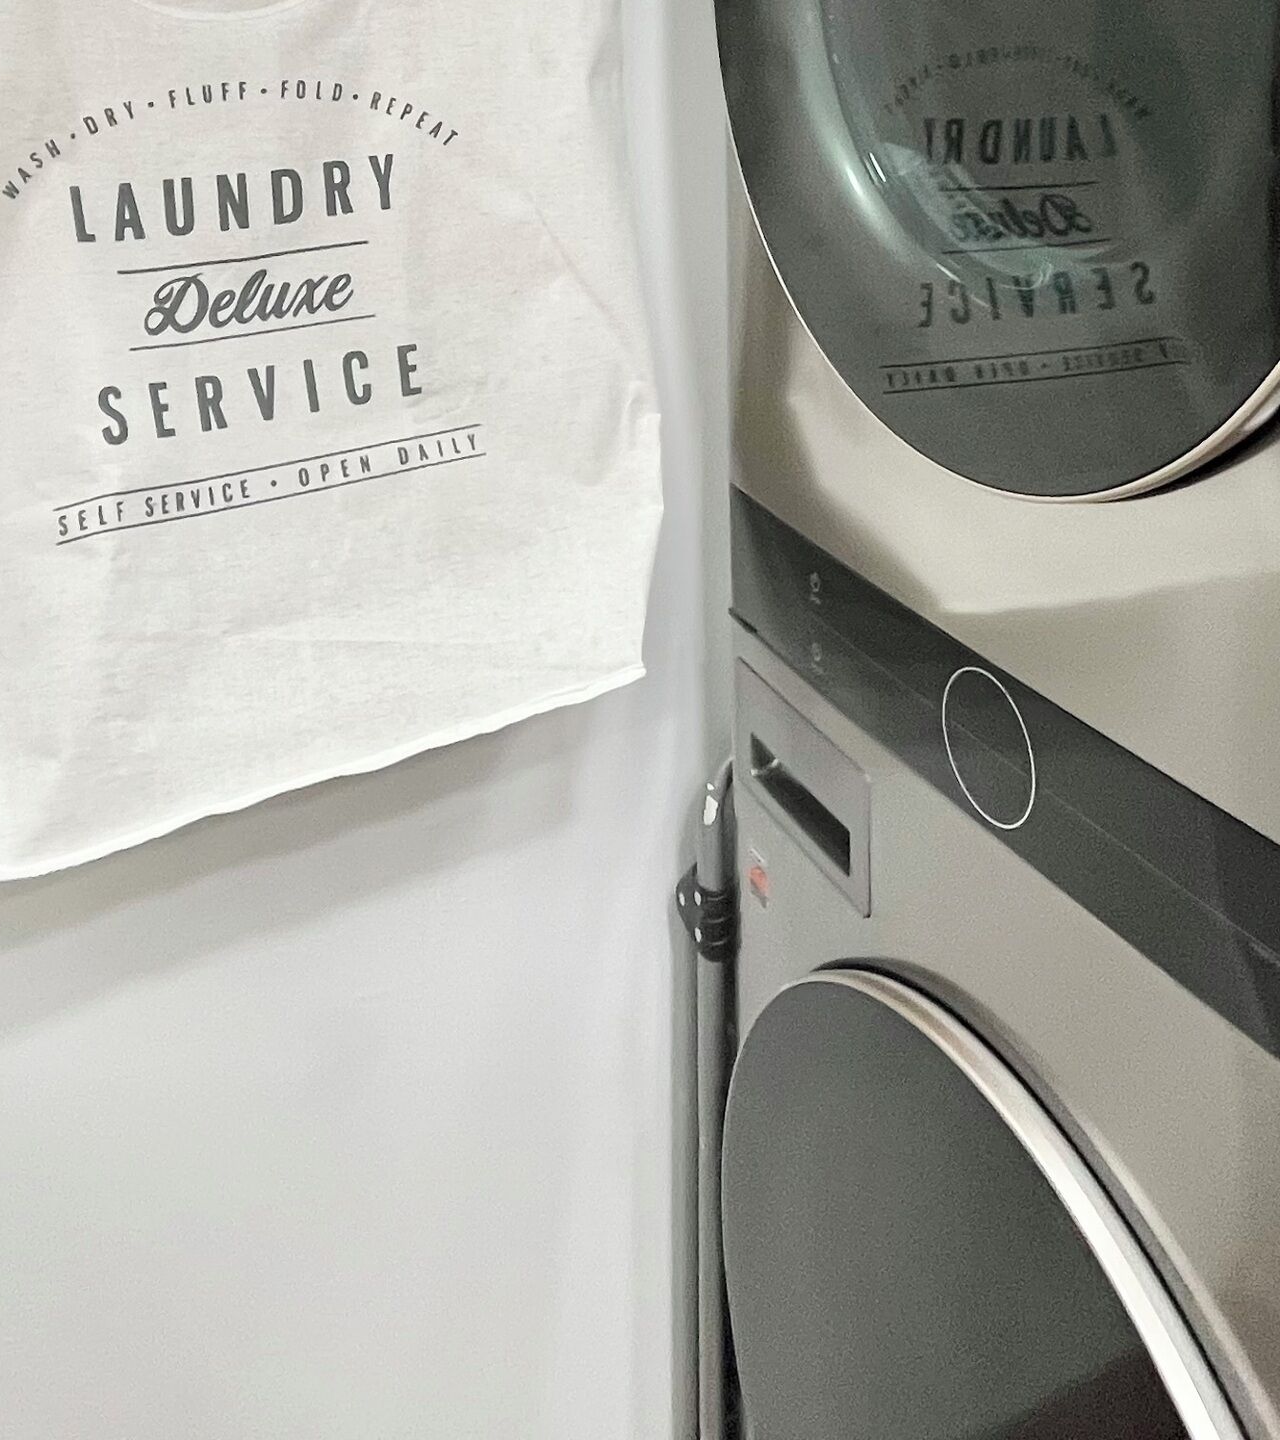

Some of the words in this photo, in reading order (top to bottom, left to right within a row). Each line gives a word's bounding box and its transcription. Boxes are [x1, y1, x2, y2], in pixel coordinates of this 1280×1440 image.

[1, 137, 61, 201] WASH
[82, 100, 135, 135] DRY
[167, 81, 248, 109] FLUFF
[280, 79, 344, 102] FOLD
[369, 91, 460, 147] REPEAT
[69, 153, 396, 243] LAUNDRY
[142, 270, 355, 337] Deluxe
[97, 343, 424, 446] SERVICE
[57, 500, 126, 538] SELF
[144, 478, 252, 518] SERVICE
[297, 454, 373, 488] OPEN
[396, 433, 479, 466] DAILY
